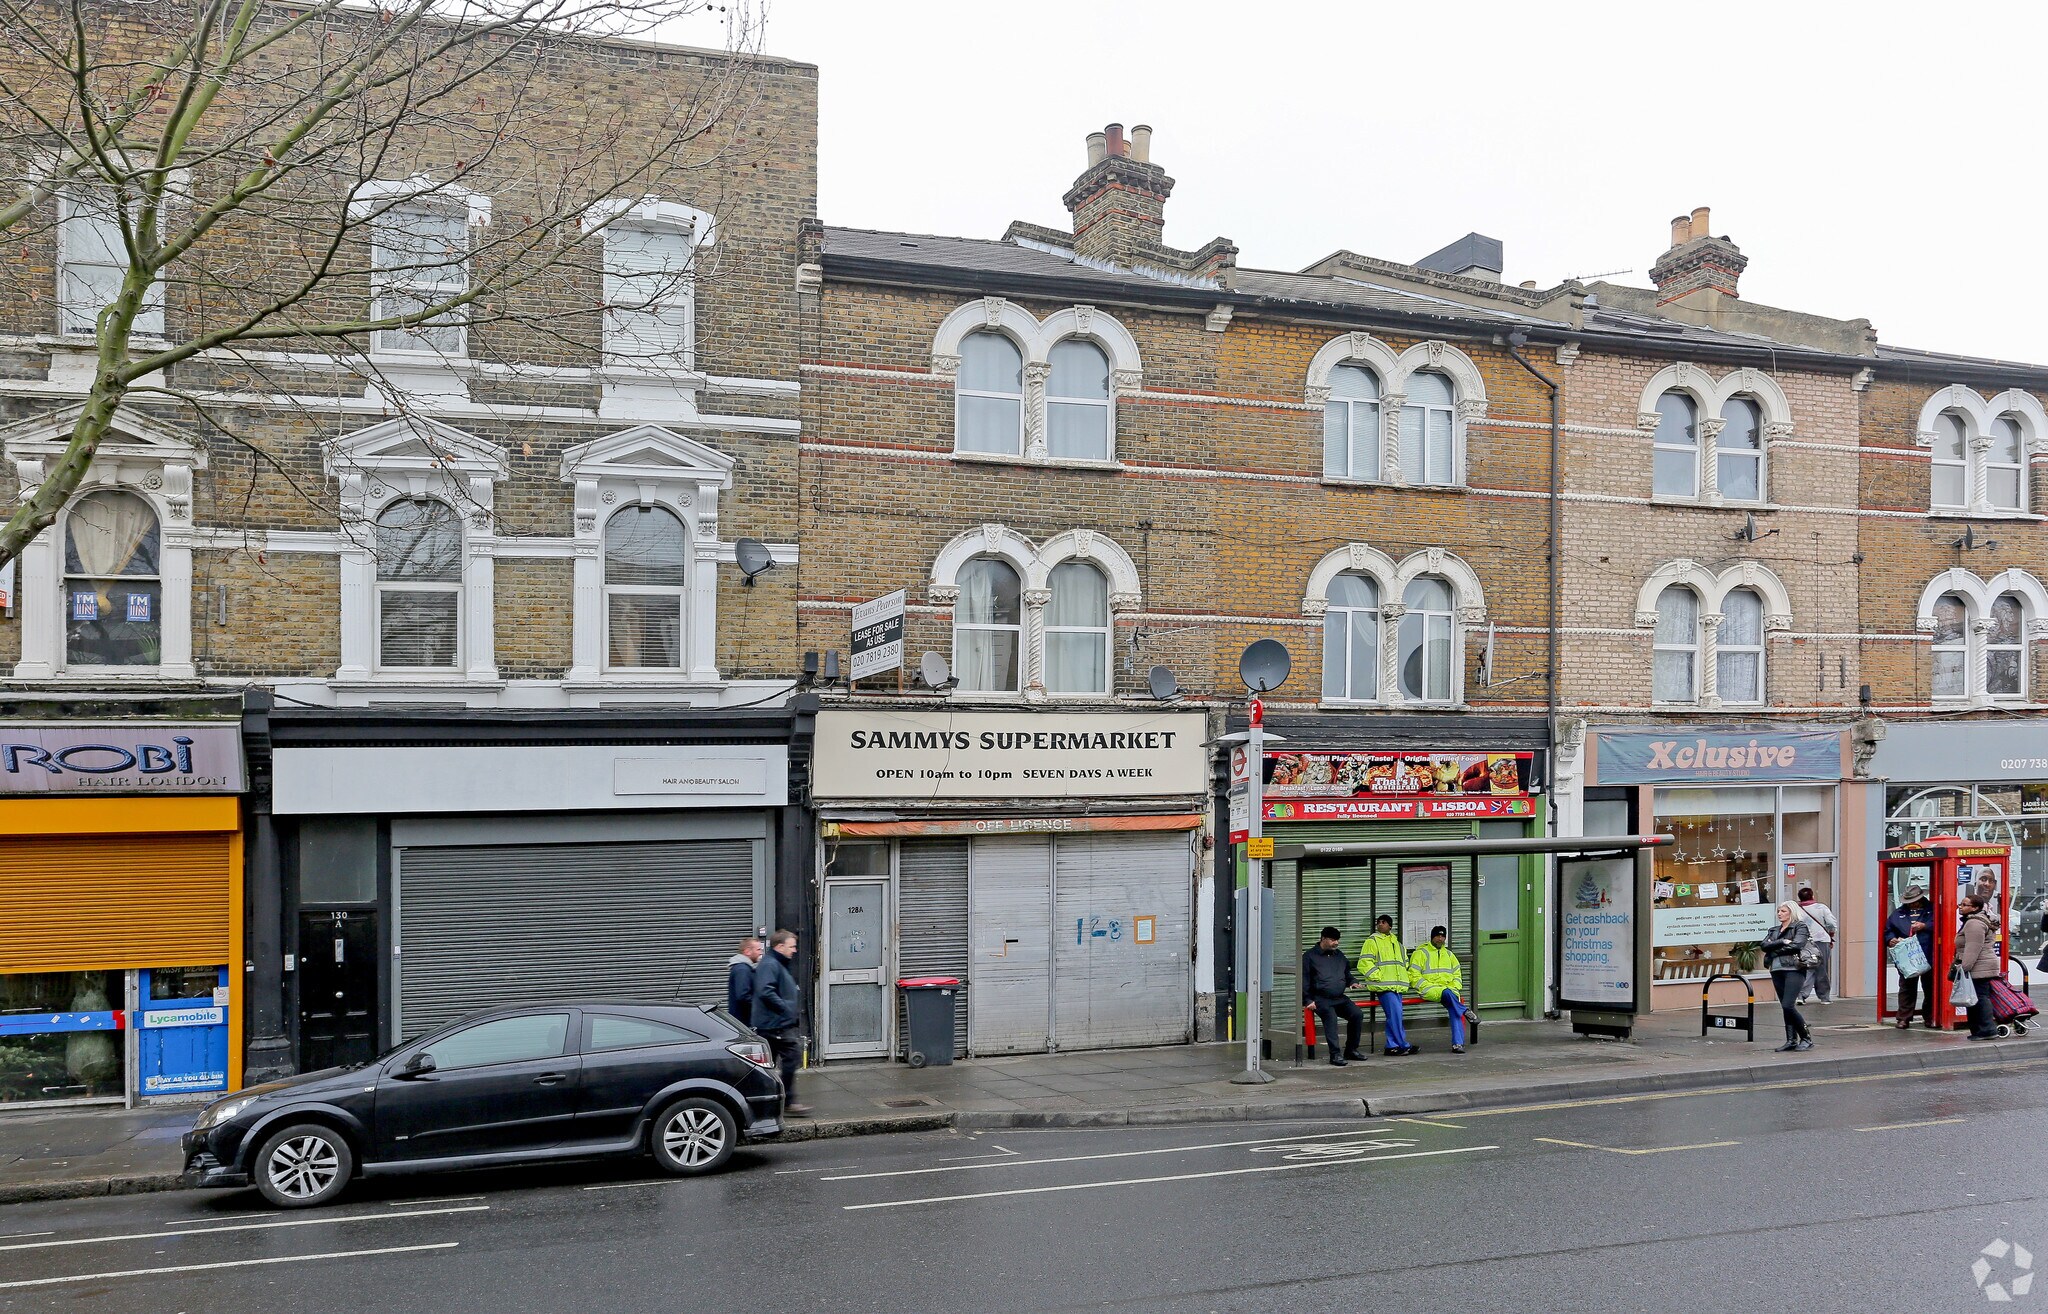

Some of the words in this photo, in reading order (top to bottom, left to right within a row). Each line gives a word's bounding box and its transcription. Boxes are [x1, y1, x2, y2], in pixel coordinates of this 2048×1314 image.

[854, 627, 872, 642] LEASE
[871, 624, 884, 637] FOR
[883, 618, 900, 632] SALE
[874, 632, 886, 645] USE
[853, 655, 865, 668] 020
[866, 649, 881, 663] 7819
[882, 643, 899, 658] 2380
[1251, 703, 1258, 722] F
[850, 730, 971, 750] SAMMYS
[979, 731, 1177, 750] SUPERMARKET
[1309, 754, 1331, 762] Small
[1356, 755, 1371, 763] Big
[1404, 755, 1433, 763] Original
[1434, 754, 1460, 762] Grilled
[1647, 739, 1796, 769] Xclusive
[2001, 759, 2026, 769] 0207
[2030, 758, 2048, 769] 738
[876, 769, 914, 779] OPEN
[919, 769, 954, 779] 10am
[958, 770, 972, 779] to
[978, 769, 1012, 782] 10pm
[1022, 769, 1065, 779] SEVEN
[1069, 769, 1102, 779] DAYS
[1105, 769, 1115, 778] A
[1117, 768, 1153, 778] WEEK
[77, 776, 131, 787] HAIR
[135, 776, 227, 787] LONDON
[1371, 783, 1420, 791] Restaurant
[1374, 777, 1409, 786] That's
[1409, 777, 1419, 785] It
[1303, 803, 1413, 813] RESTAURANT
[1432, 802, 1487, 811] LISBOA
[975, 820, 1003, 832] OFF
[1909, 850, 1925, 858] here
[1958, 848, 2005, 856] TELEPHONE
[331, 911, 348, 919] 130
[1565, 913, 1582, 925] Get
[1583, 912, 1630, 924] cashback
[335, 920, 342, 928] A
[1578, 927, 1599, 938] your
[1565, 938, 1613, 949] Christmas
[1565, 951, 1610, 964] shopping.
[149, 1012, 218, 1025] Lycamobile
